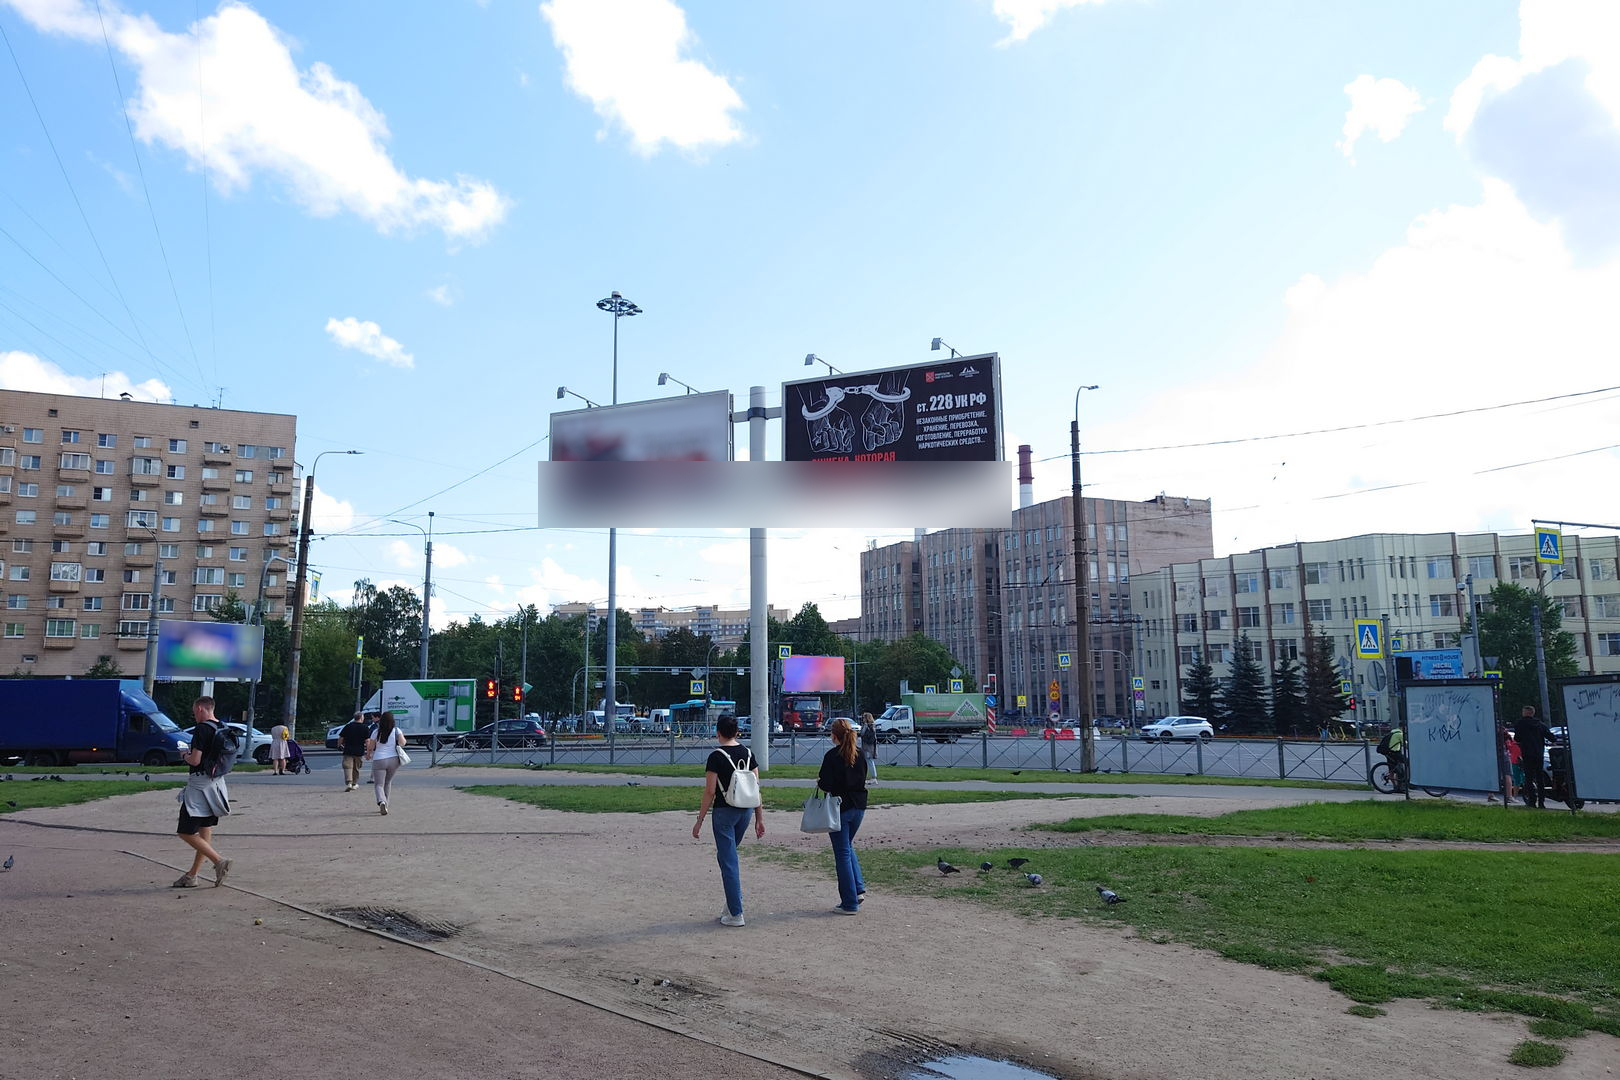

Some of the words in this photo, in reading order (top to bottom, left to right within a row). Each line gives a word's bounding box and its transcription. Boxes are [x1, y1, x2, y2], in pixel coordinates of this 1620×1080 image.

[929, 394, 953, 411] 228
[954, 394, 968, 409] УК
[969, 392, 987, 407] РФ
[916, 414, 948, 425] НЕЗАКОННЫЕ
[949, 420, 979, 430] ПЕРЕВОЗКА,
[953, 427, 988, 438] ПЕРЕРАБОТКА
[918, 439, 959, 450] НАРКОТИЧЕСКИХ
